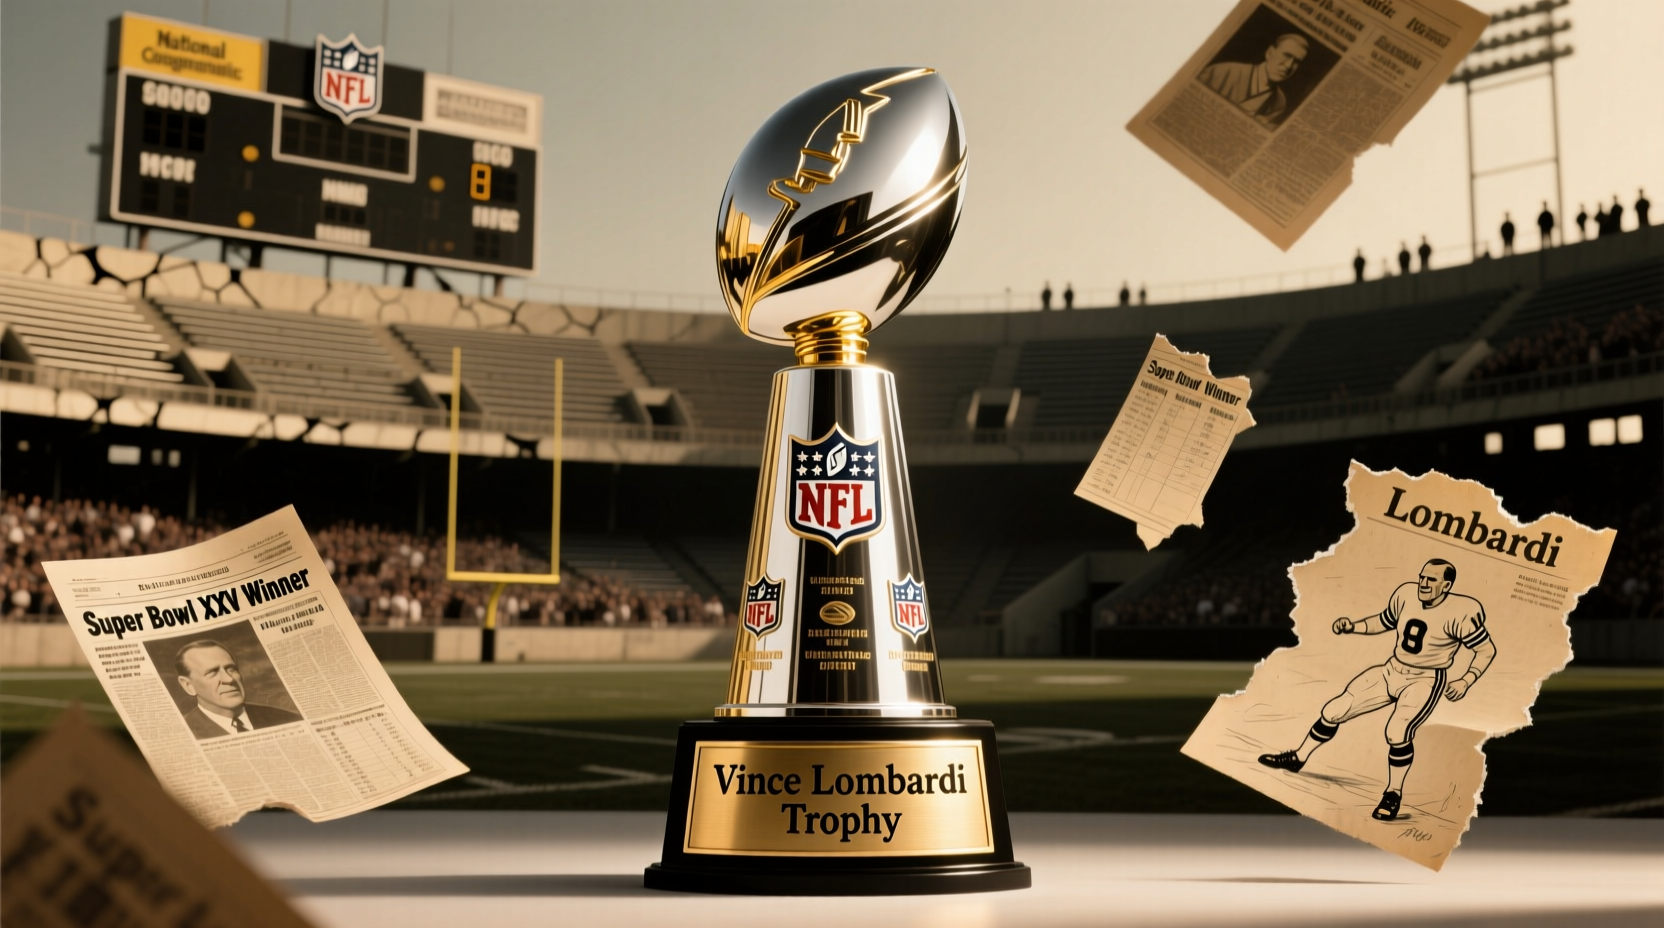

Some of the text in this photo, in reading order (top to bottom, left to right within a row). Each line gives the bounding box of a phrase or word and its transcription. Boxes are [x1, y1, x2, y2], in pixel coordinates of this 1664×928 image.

[157, 29, 225, 59] National
[325, 72, 370, 105] NFL
[470, 163, 491, 201] 8
[798, 482, 872, 530] NFL
[1384, 486, 1563, 567] Lombardi
[83, 610, 144, 640] Super
[145, 598, 199, 629] Bowl
[197, 587, 240, 620] XXV
[240, 568, 309, 607] Winner
[747, 602, 774, 627] NFL
[898, 603, 925, 628] NFL
[1401, 619, 1428, 654] 8
[714, 764, 967, 796] Vince Lombardi
[781, 803, 902, 843] Trophy
